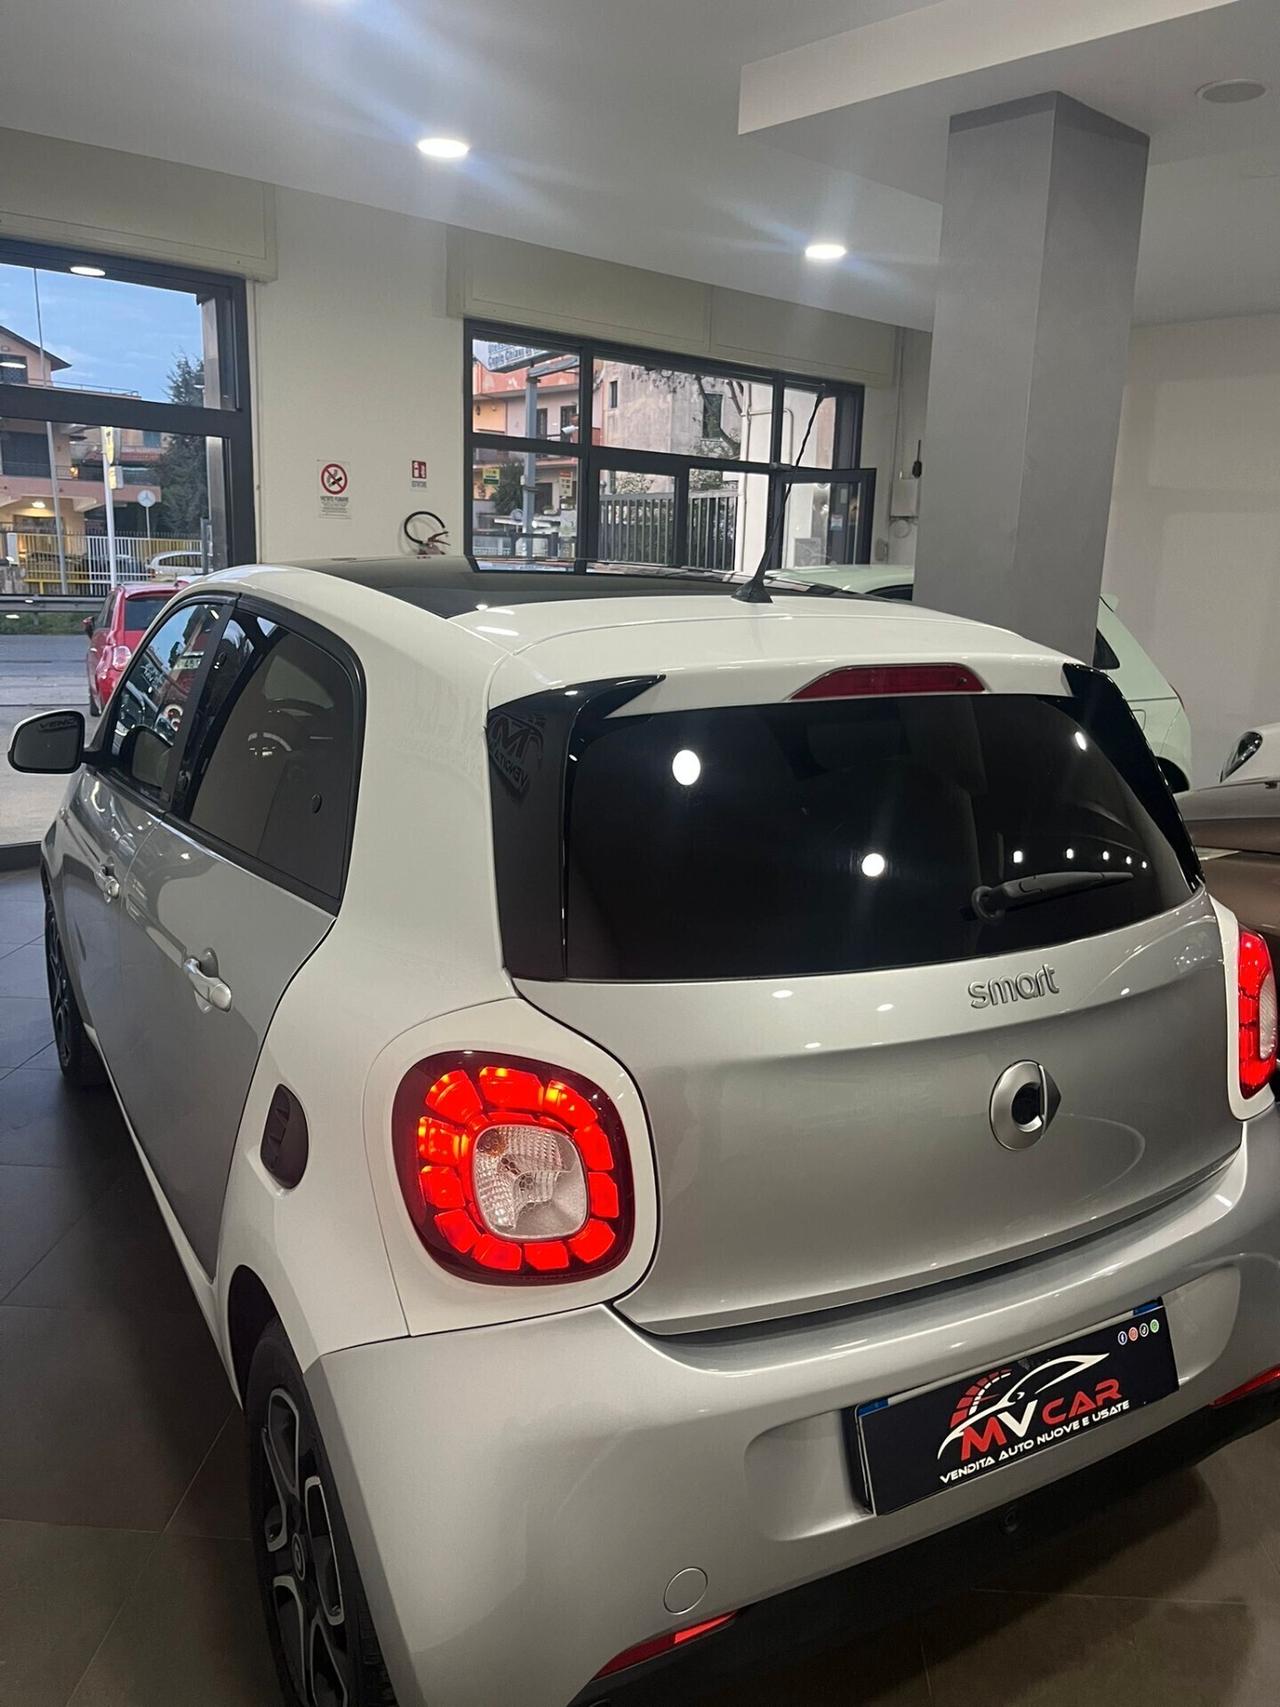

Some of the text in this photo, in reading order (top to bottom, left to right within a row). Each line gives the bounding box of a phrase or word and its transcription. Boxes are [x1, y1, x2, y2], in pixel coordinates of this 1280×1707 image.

[968, 964, 1059, 1009] smart
[940, 1400, 1130, 1483] VENDITA AUTO NUOVE E USATE
[961, 1379, 1122, 1461] MV CAR
